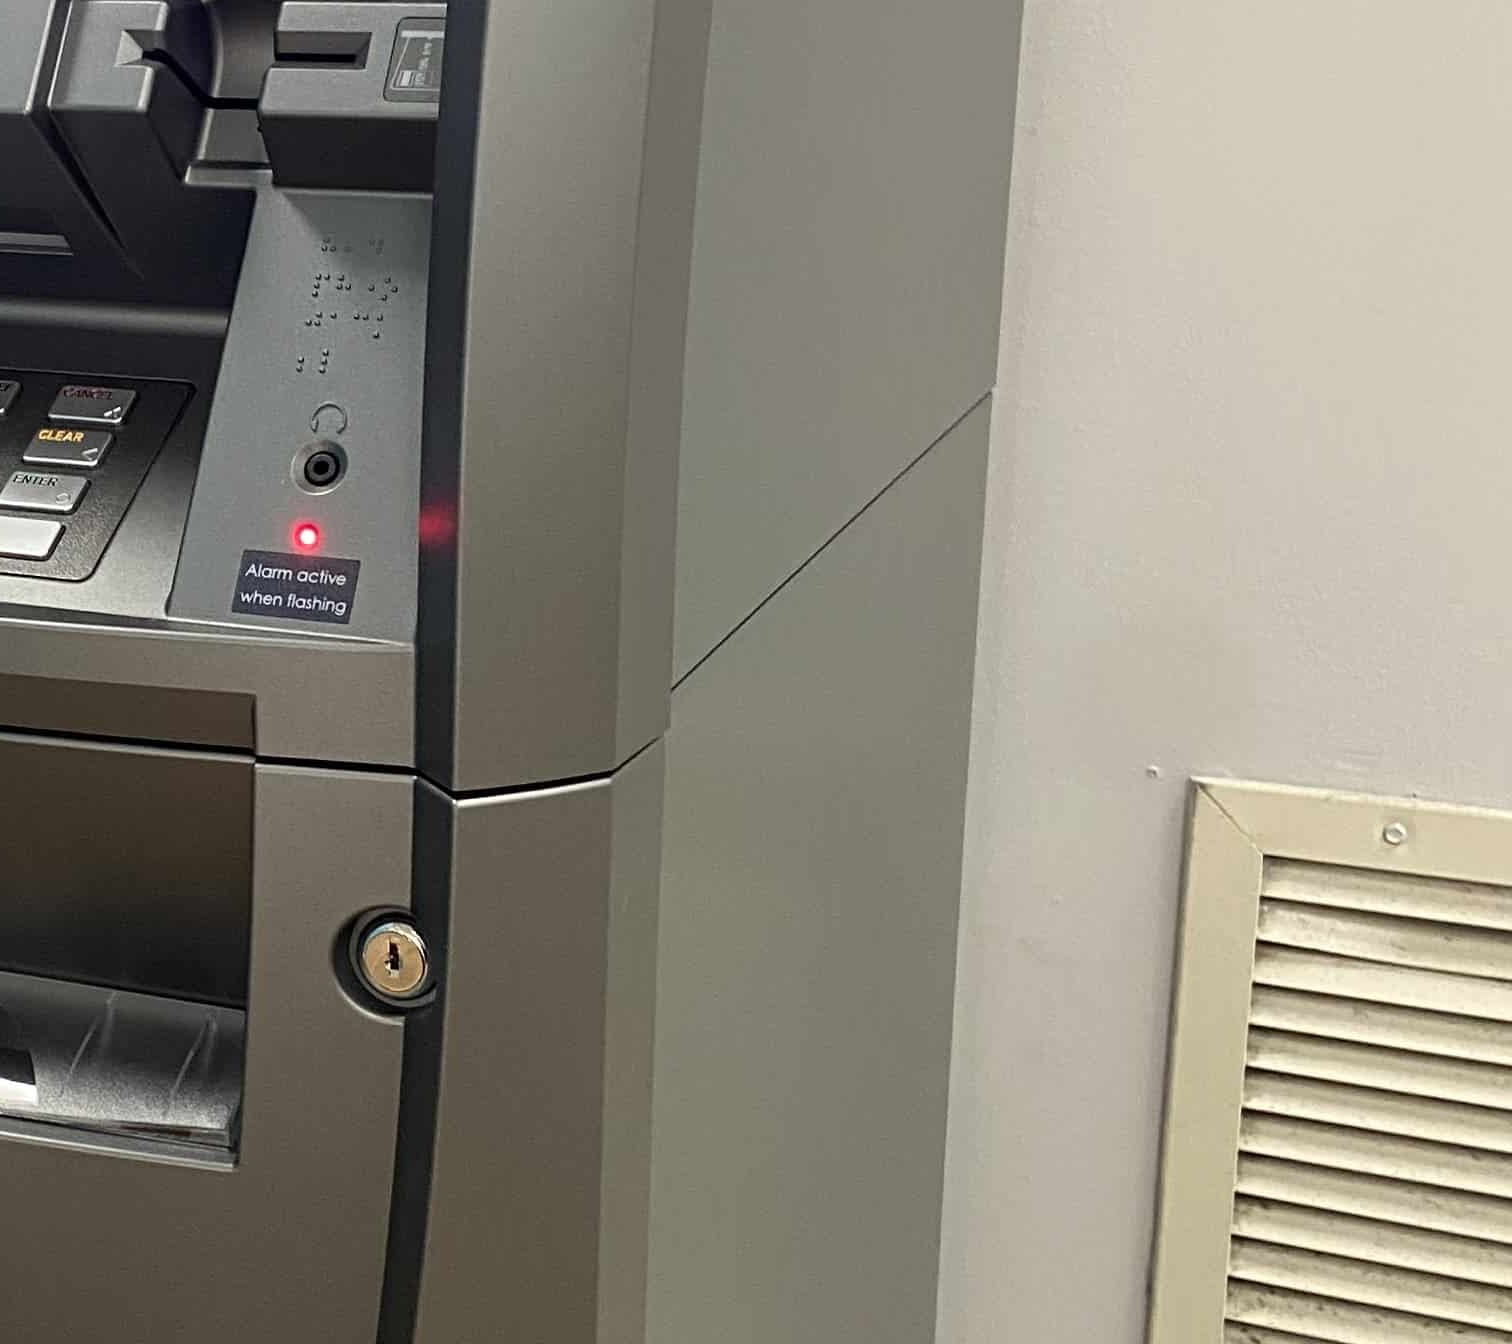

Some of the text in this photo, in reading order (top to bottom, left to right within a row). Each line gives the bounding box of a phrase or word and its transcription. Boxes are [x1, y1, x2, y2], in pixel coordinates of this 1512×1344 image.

[38, 429, 85, 443] CLEAR
[12, 474, 59, 487] ENTER
[245, 563, 346, 586] Alarm active
[240, 590, 347, 616] when flashing
